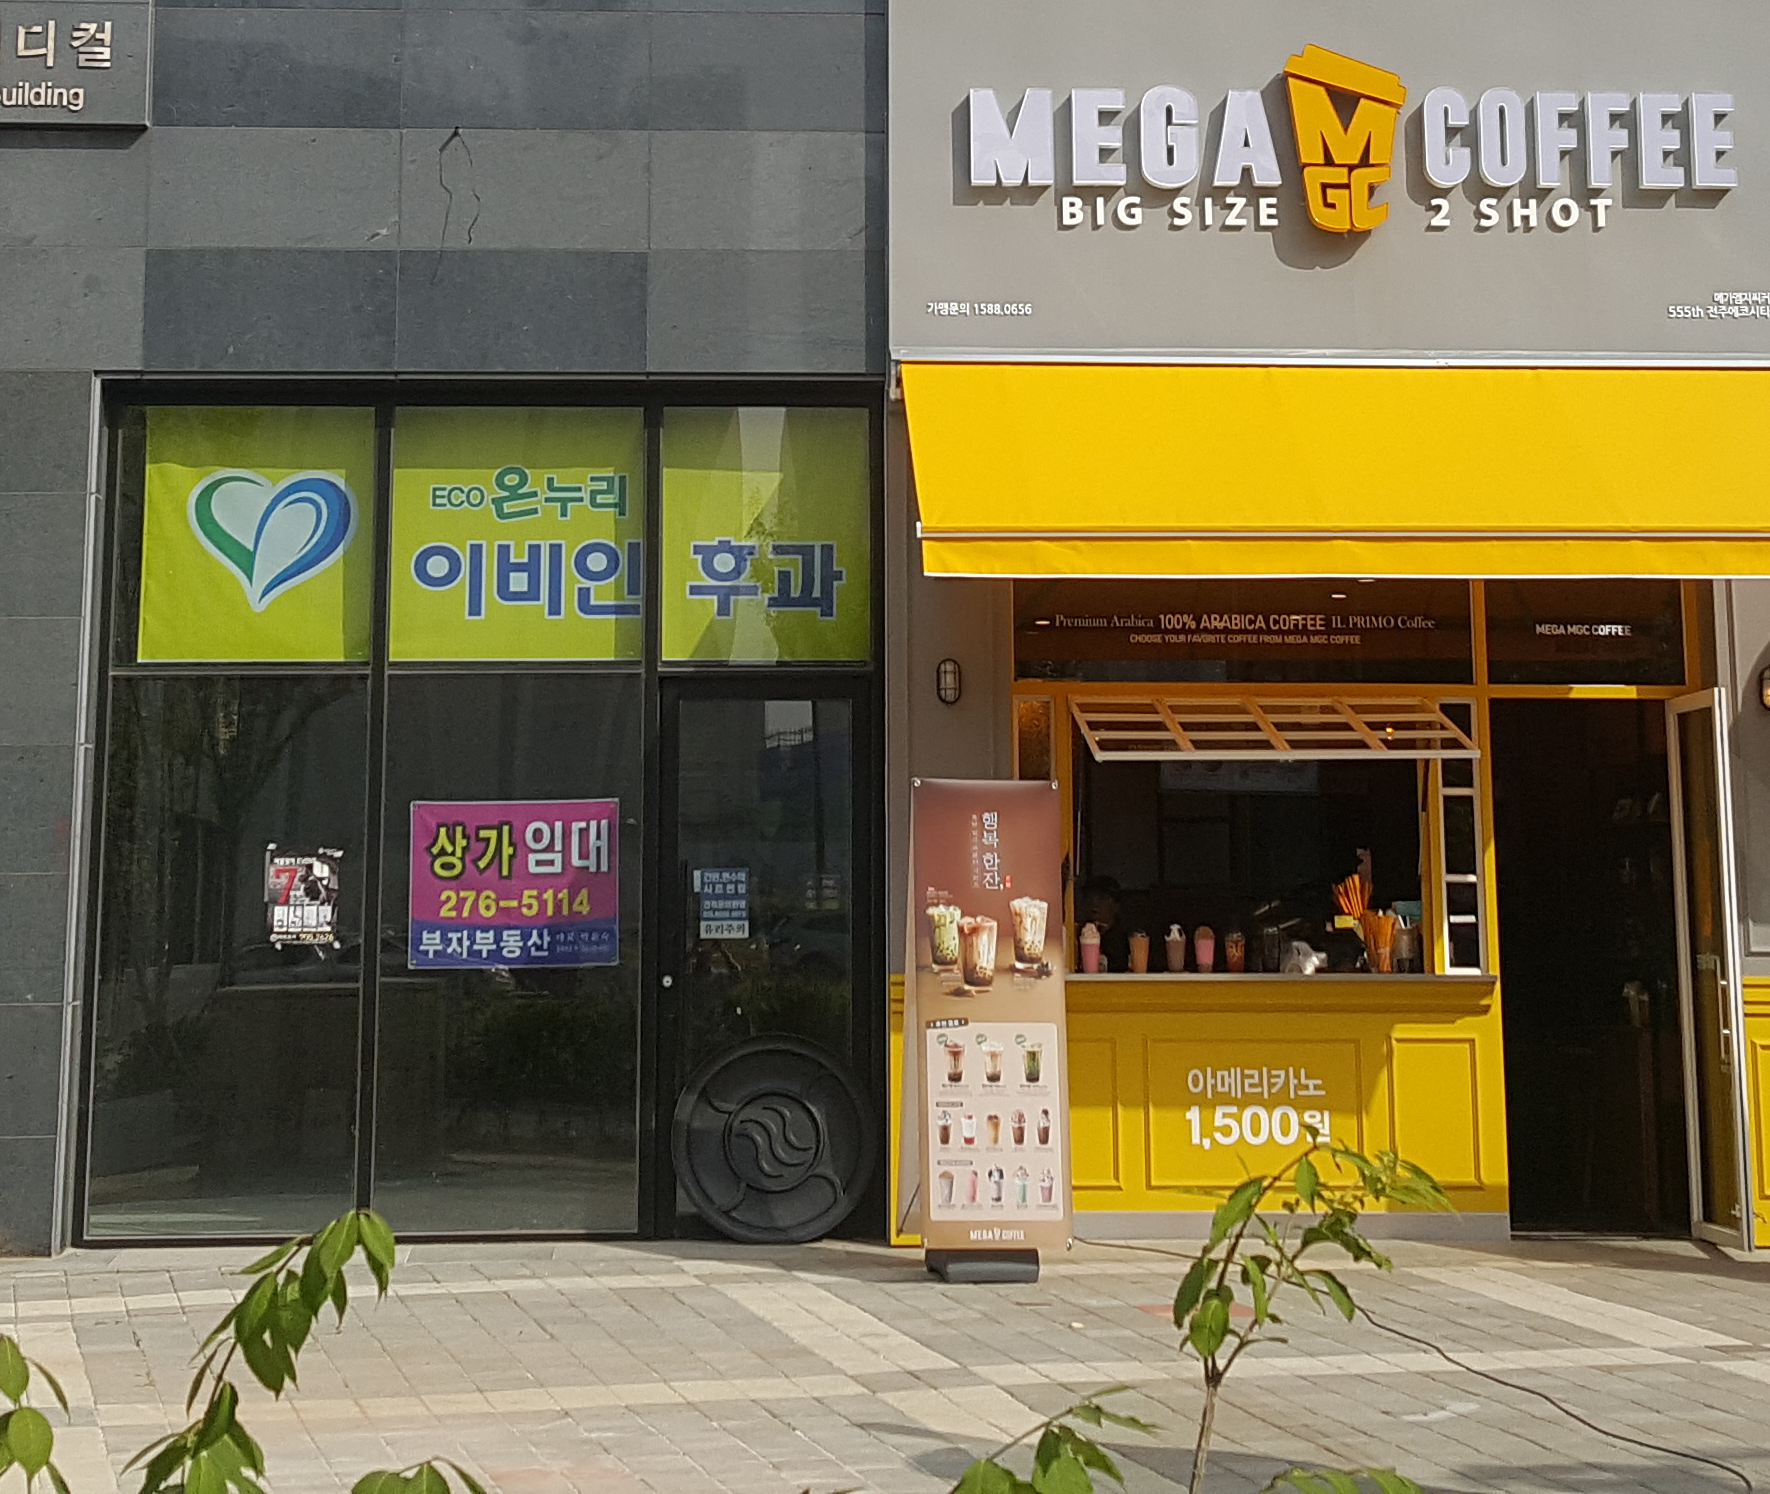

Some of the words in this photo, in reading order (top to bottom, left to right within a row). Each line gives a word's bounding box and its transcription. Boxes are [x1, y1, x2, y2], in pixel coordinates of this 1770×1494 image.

[967, 85, 1282, 189] MEGA
[1422, 85, 1737, 190] COFFEE
[1062, 198, 1144, 229] BIG
[1172, 195, 1279, 228] SIZE
[1429, 200, 1450, 228] 2
[1477, 198, 1612, 230] SHOT
[927, 302, 969, 315] 가맹문의
[974, 303, 1032, 315] 1588.0656
[1668, 306, 1704, 317] 555th
[1055, 614, 1107, 627] Premium
[1110, 614, 1154, 627] Arabica
[1159, 614, 1196, 629] 100%
[1200, 614, 1266, 630] ARABICA
[1269, 615, 1325, 630] COFFEE
[1331, 616, 1345, 628] IL
[1349, 616, 1394, 629] PRIMO
[1397, 617, 1435, 629] Coffee
[1535, 624, 1566, 635] MEGA
[1567, 624, 1590, 635] MGC
[1592, 625, 1632, 636] COFFEE
[1227, 634, 1257, 643] COFFEE
[1330, 635, 1361, 644] COFFEE
[439, 888, 591, 918] 276-5114
[418, 929, 550, 959] 부자부동산
[1187, 1067, 1326, 1099] 아메리카노
